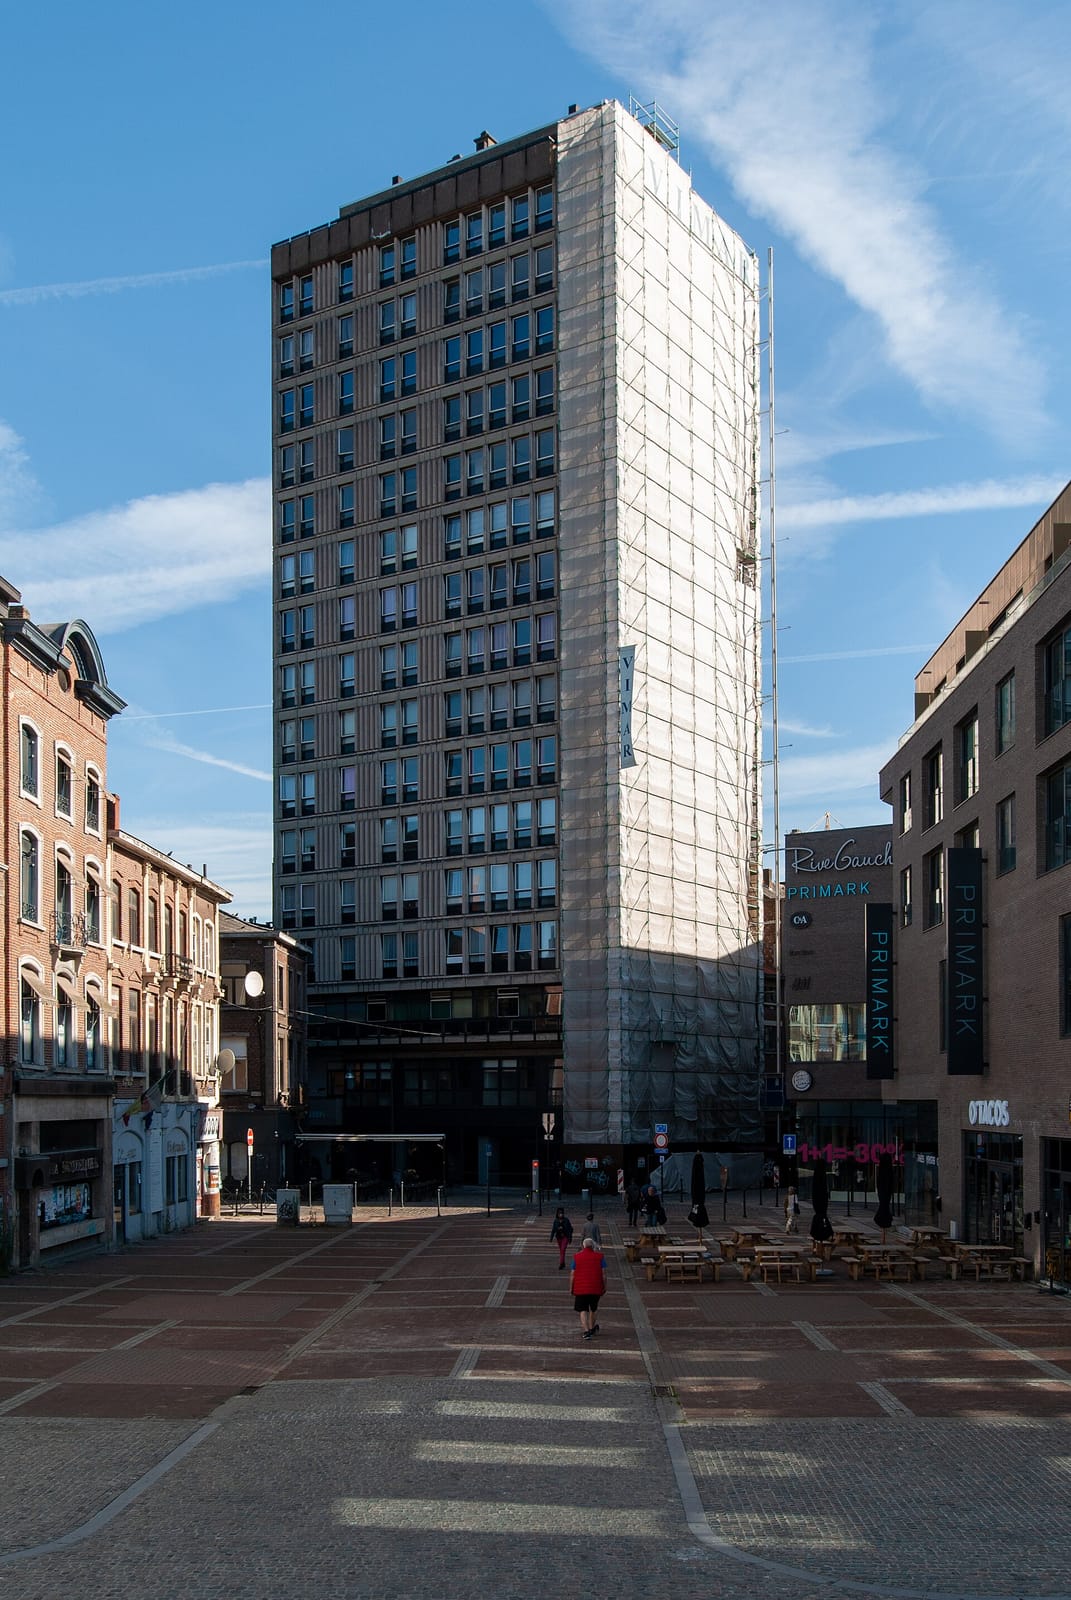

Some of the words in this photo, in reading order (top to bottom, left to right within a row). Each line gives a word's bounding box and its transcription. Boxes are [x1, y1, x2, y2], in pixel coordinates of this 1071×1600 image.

[622, 656, 634, 758] VIMAR
[786, 847, 834, 874] Rive
[834, 838, 894, 871] Gauch
[787, 881, 871, 900] PRIMARK
[871, 932, 889, 1049] PRIMARK
[954, 885, 977, 1035] PRIMARK
